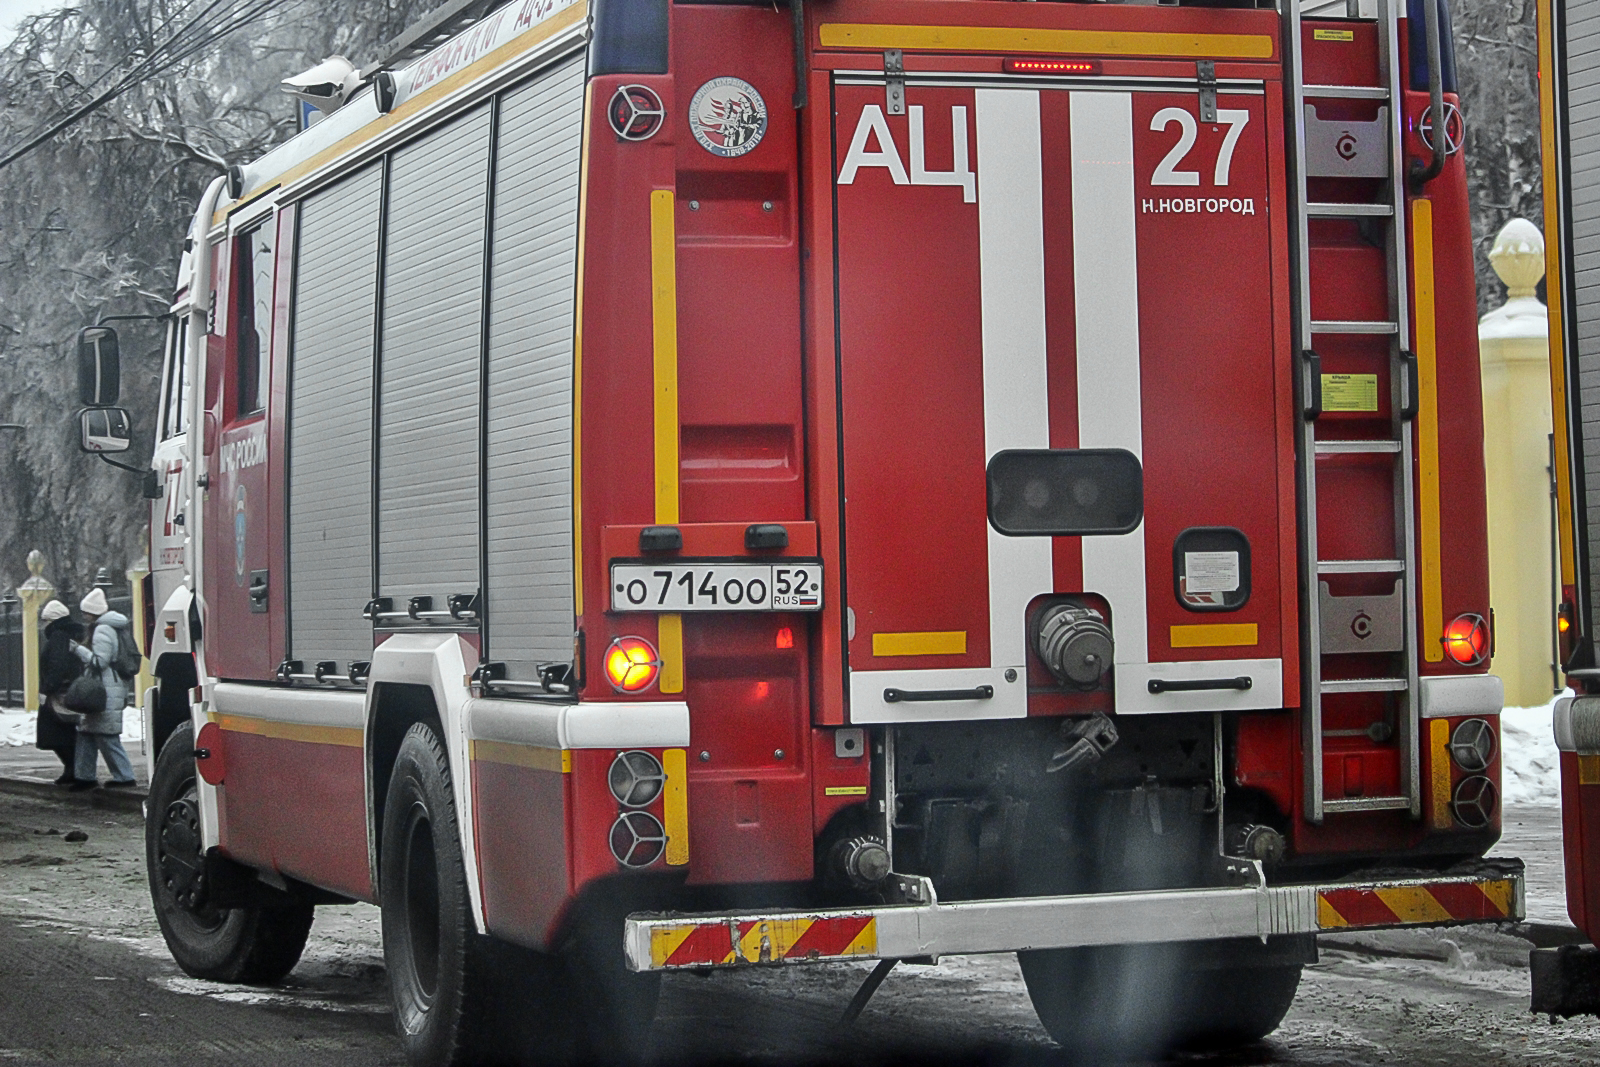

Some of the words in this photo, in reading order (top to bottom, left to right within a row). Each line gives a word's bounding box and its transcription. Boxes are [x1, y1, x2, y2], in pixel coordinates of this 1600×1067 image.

[716, 77, 747, 91] ОХРАНЕ
[745, 86, 767, 118] РОССИИ
[837, 104, 977, 204] АЦ
[1149, 106, 1250, 187] 27
[1142, 197, 1256, 216] Н.НОВГОРОД
[235, 433, 267, 470] РОССИИ
[776, 569, 810, 595] 52
[774, 596, 799, 606] RUS
